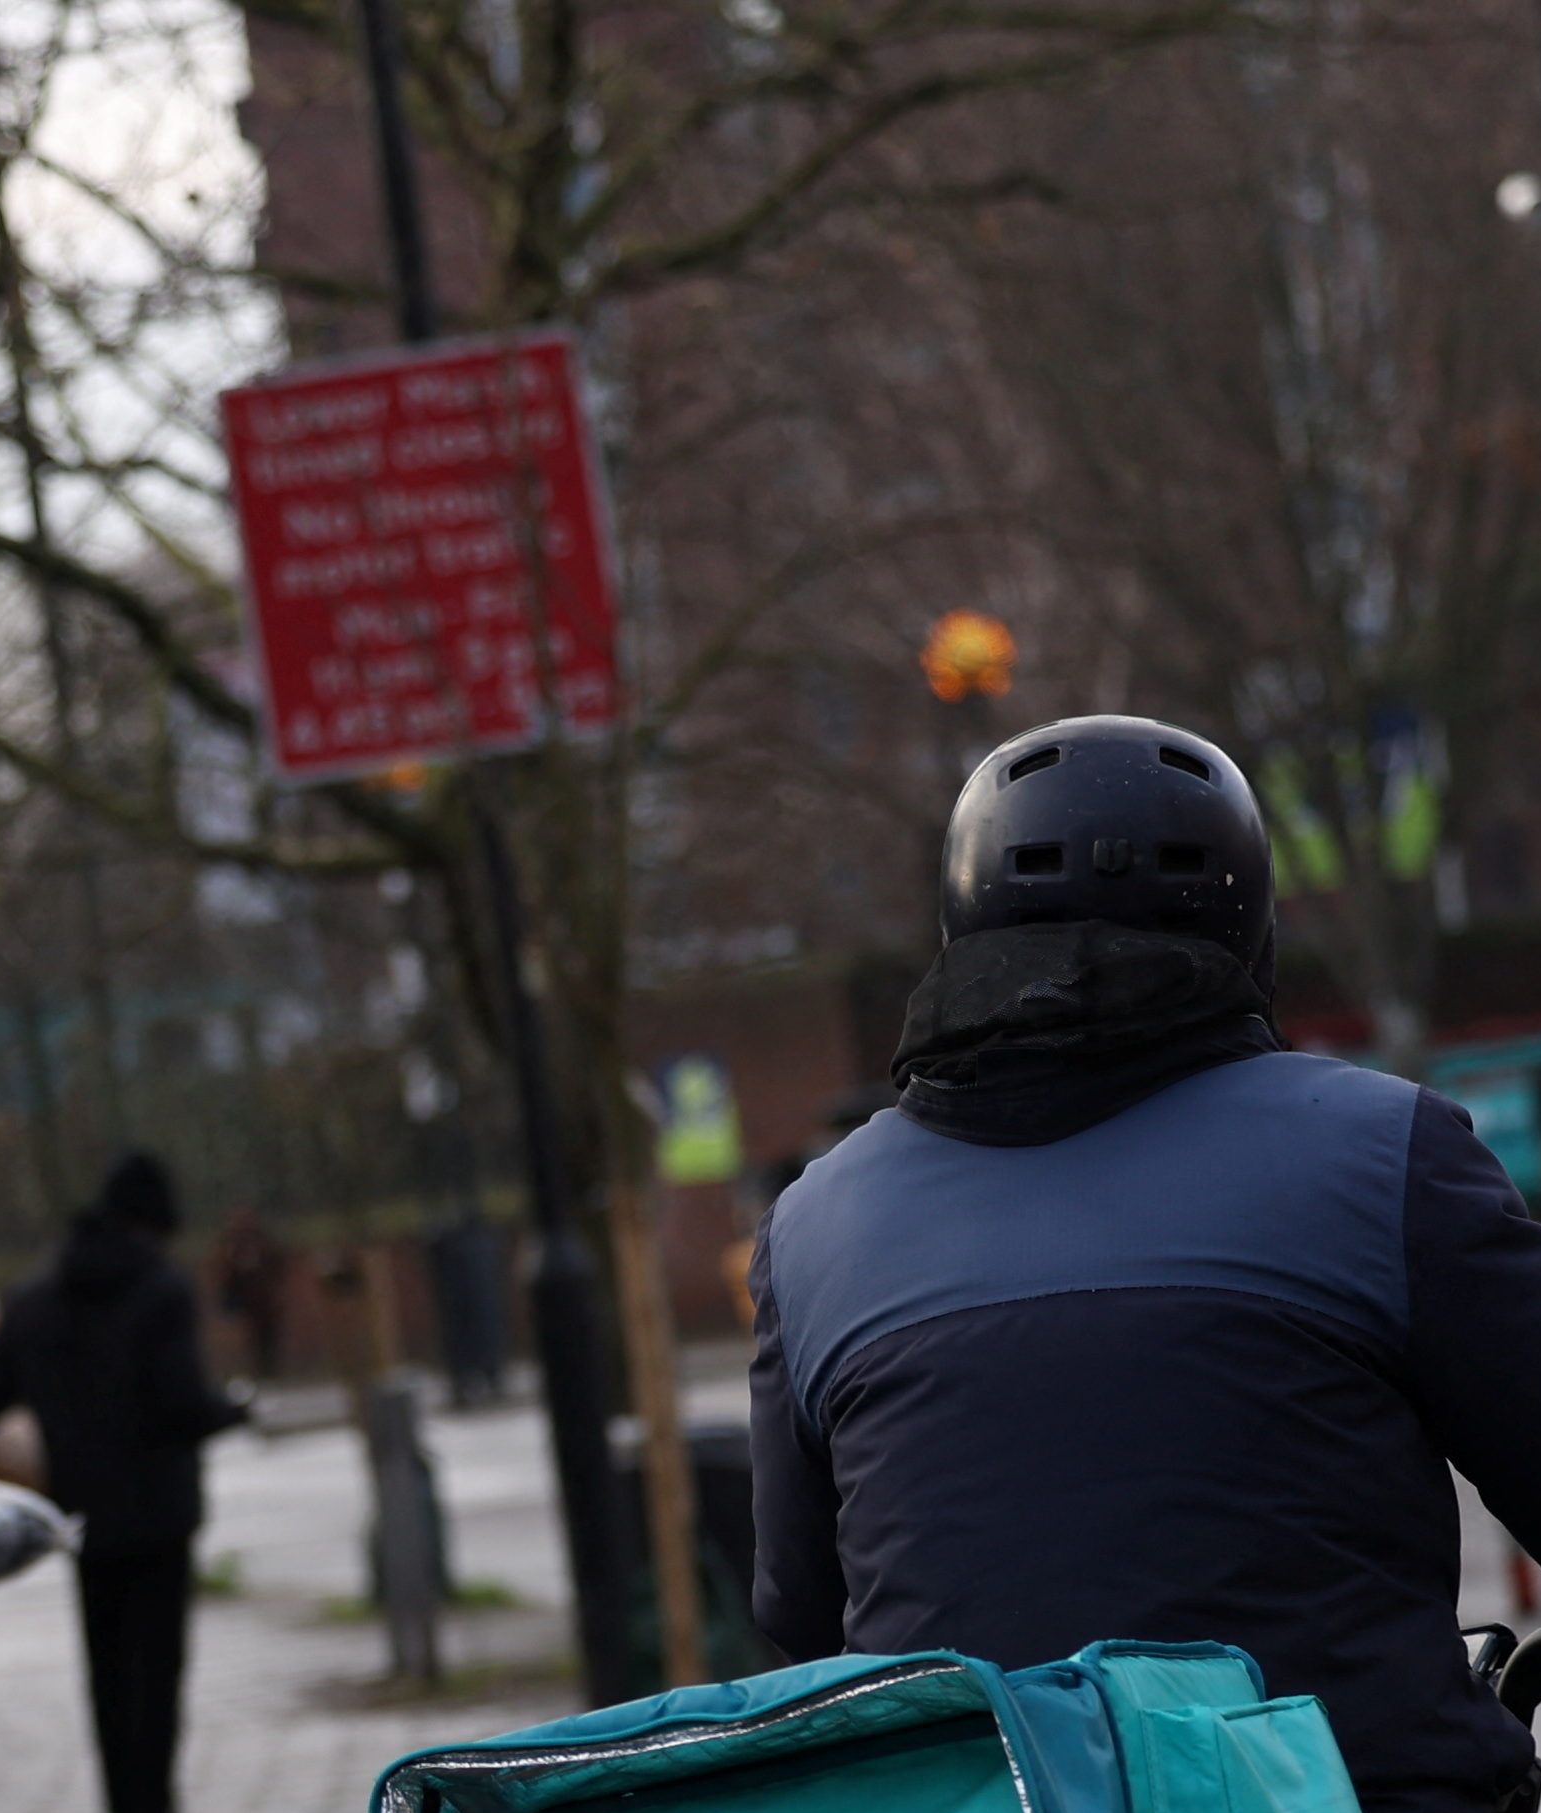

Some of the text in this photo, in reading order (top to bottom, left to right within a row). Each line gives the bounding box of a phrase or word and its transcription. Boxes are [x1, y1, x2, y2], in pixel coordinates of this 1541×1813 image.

[285, 478, 551, 543] No throu
[428, 521, 572, 570] traffc
